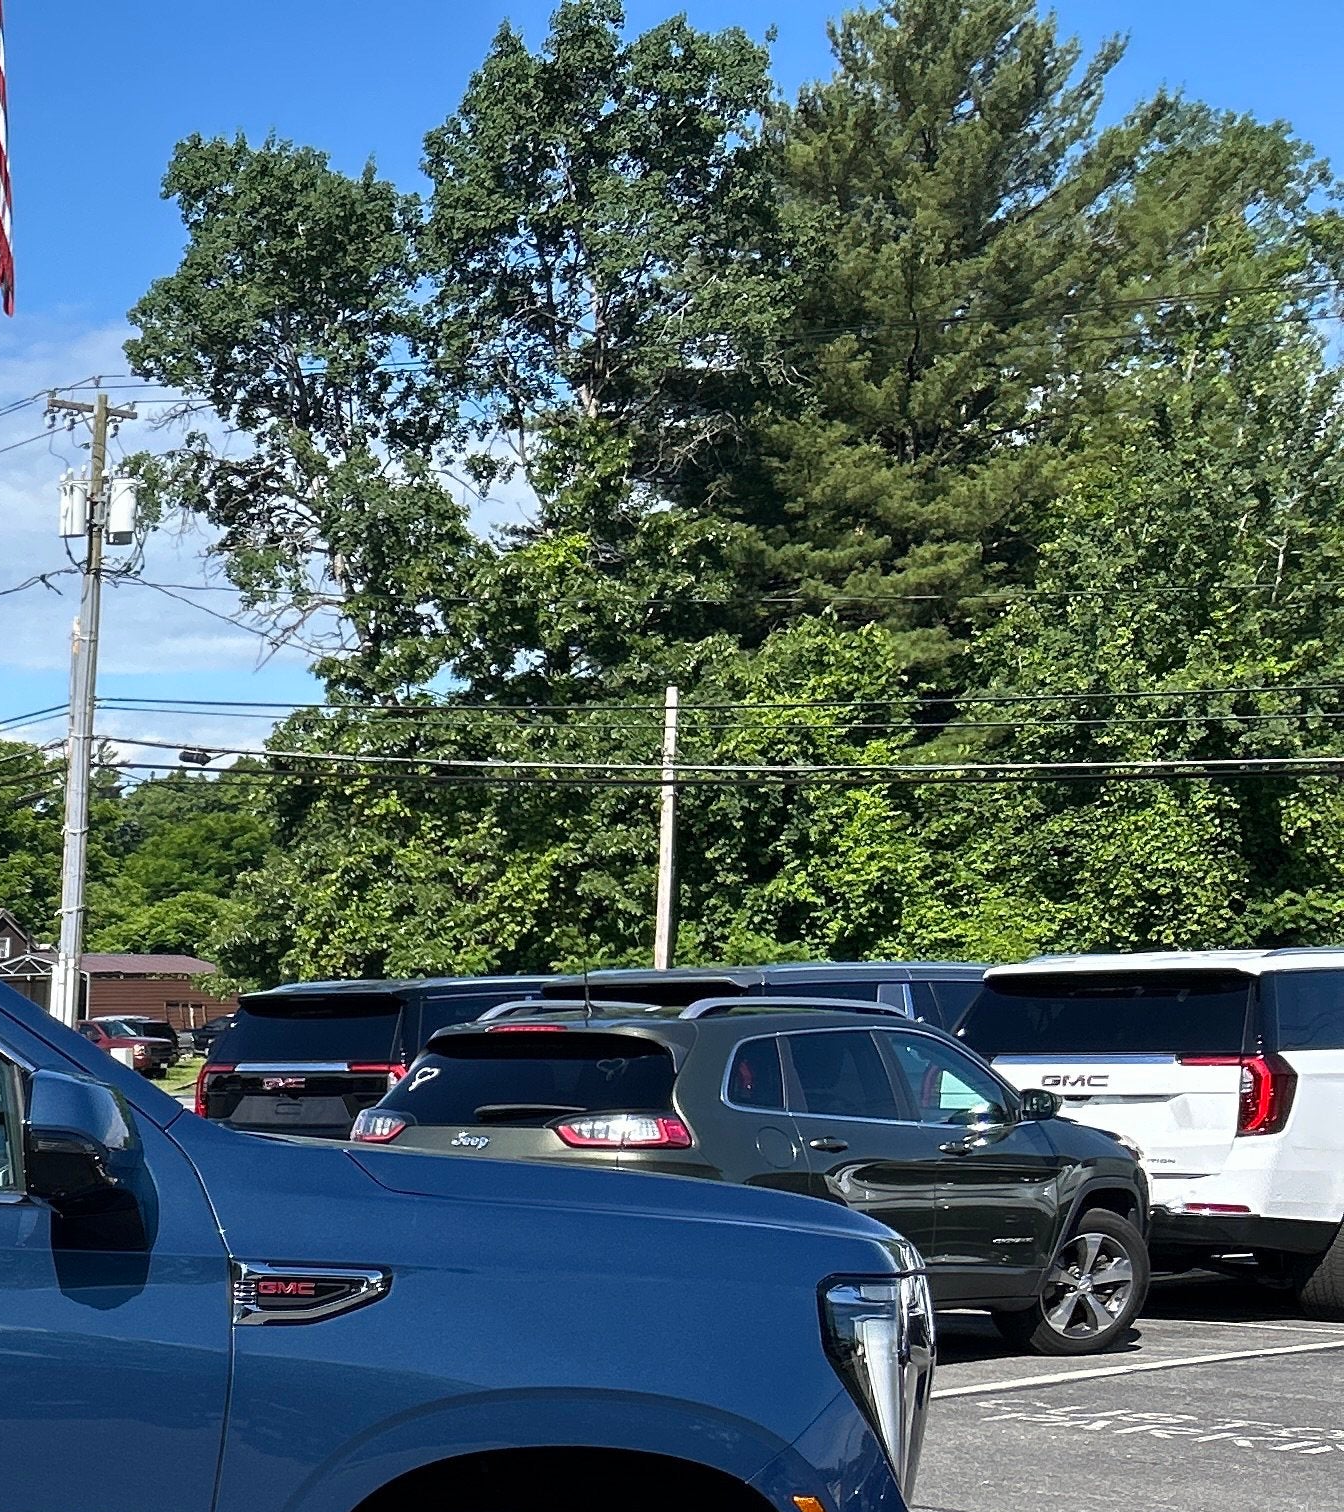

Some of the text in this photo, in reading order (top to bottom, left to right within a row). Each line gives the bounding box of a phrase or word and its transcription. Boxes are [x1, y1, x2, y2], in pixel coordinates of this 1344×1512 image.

[263, 1077, 305, 1089] GMC
[1041, 1075, 1109, 1087] GMC
[451, 1131, 489, 1150] Jeep
[258, 1281, 316, 1295] GMC
